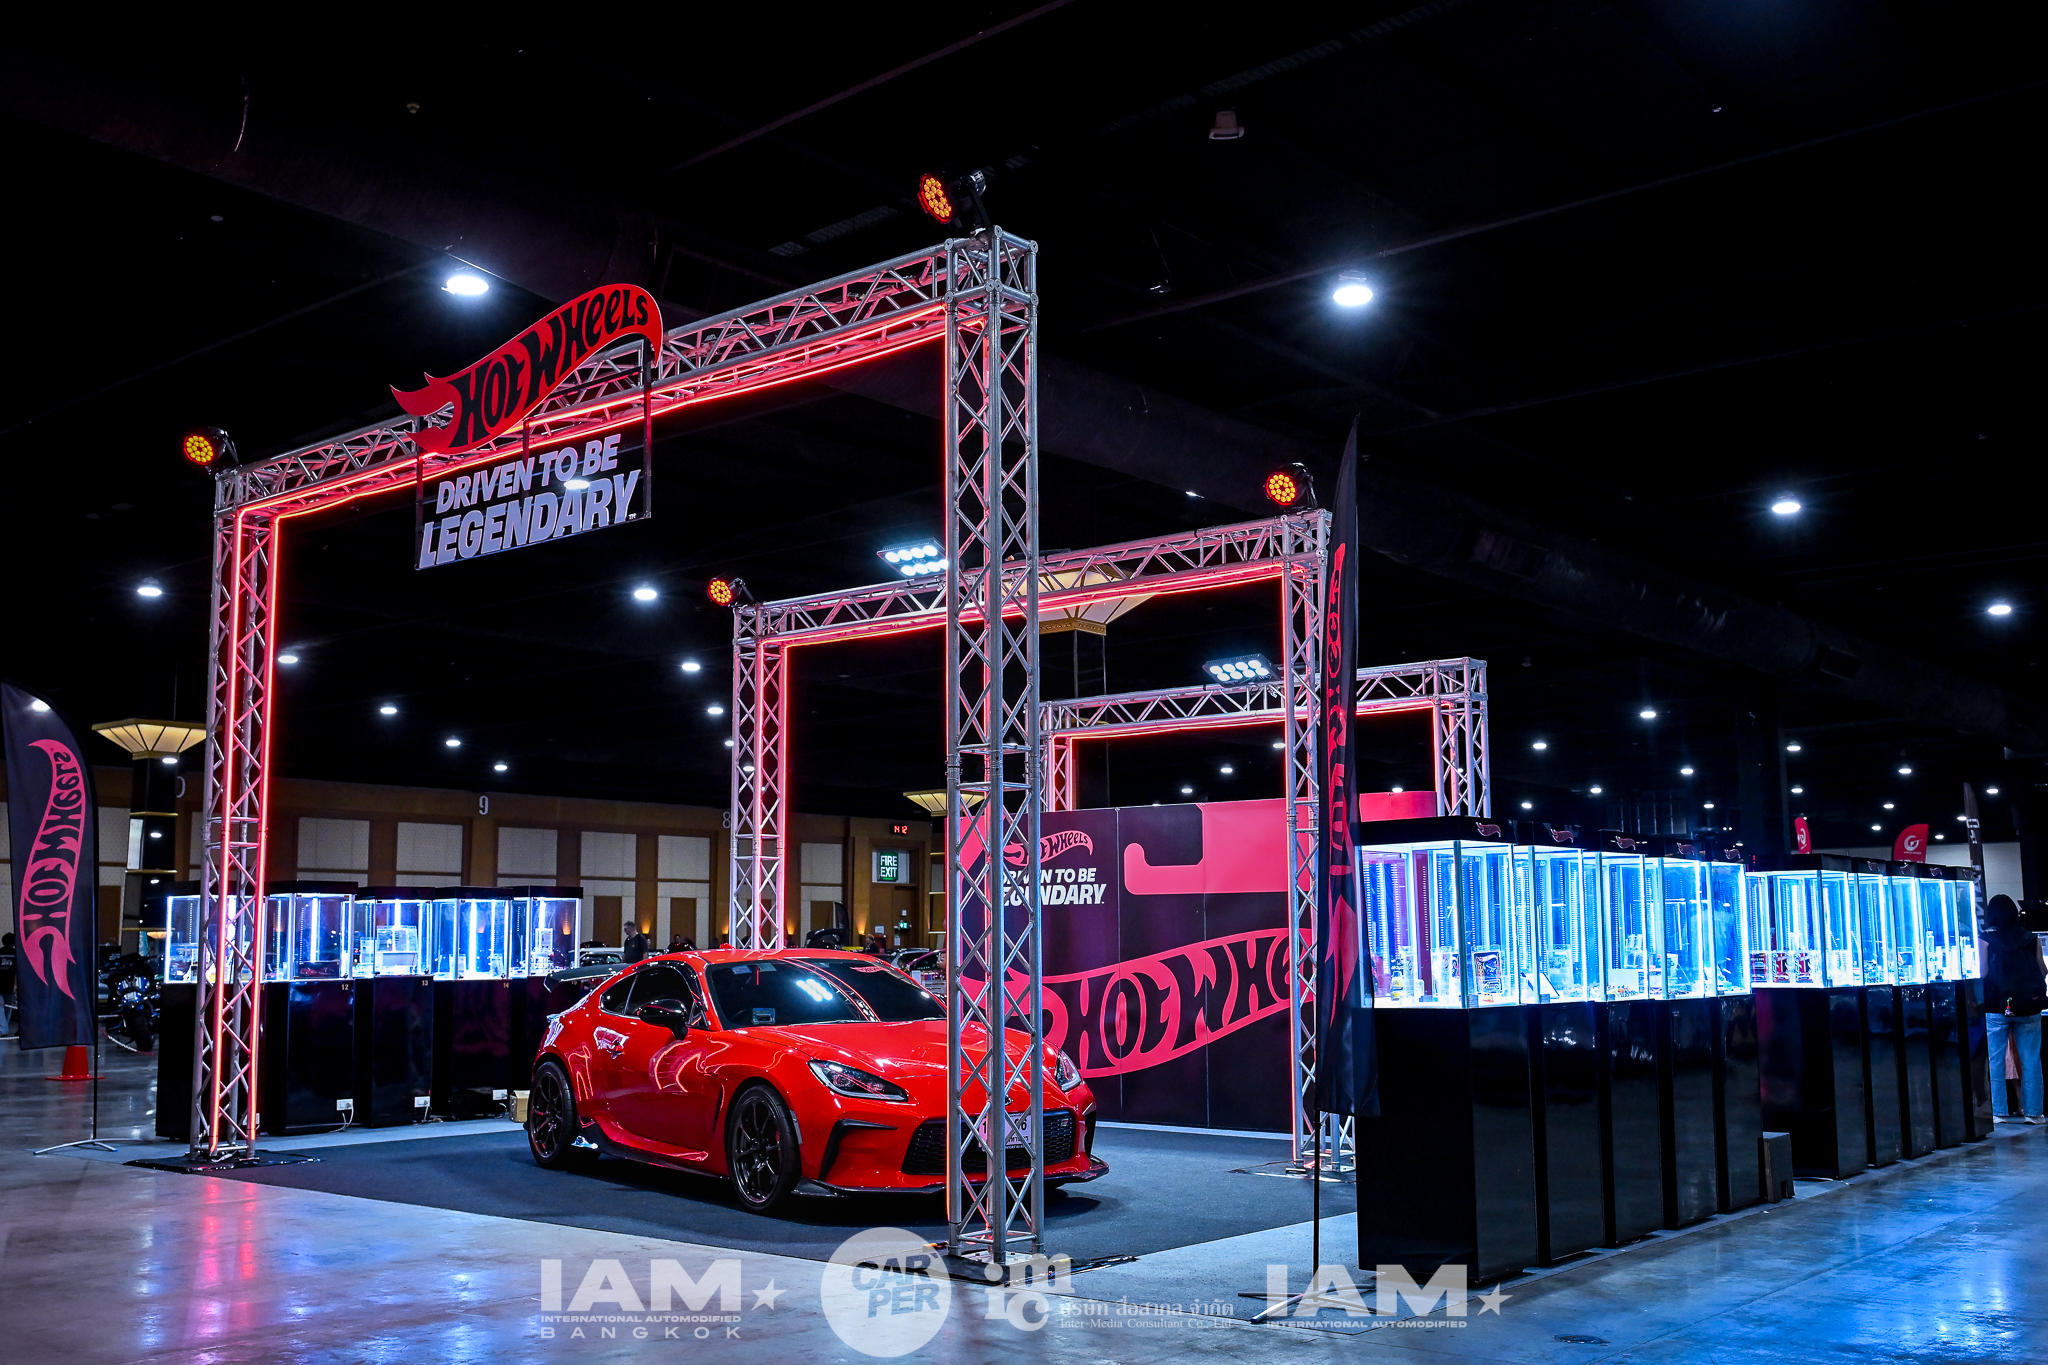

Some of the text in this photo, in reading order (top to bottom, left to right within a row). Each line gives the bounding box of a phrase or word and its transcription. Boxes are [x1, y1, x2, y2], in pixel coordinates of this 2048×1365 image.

[447, 353, 526, 448] HOT
[436, 433, 622, 514] DRIVEN TO BE
[478, 795, 489, 816] 9
[722, 811, 732, 830] 8
[880, 855, 898, 866] FIRE
[880, 867, 898, 878] EXIT
[1055, 868, 1076, 884] TO
[1078, 868, 1097, 882] BE
[341, 983, 350, 991] 12
[421, 979, 429, 987] 13
[503, 981, 510, 989] 14
[1040, 971, 1172, 1070] HOT
